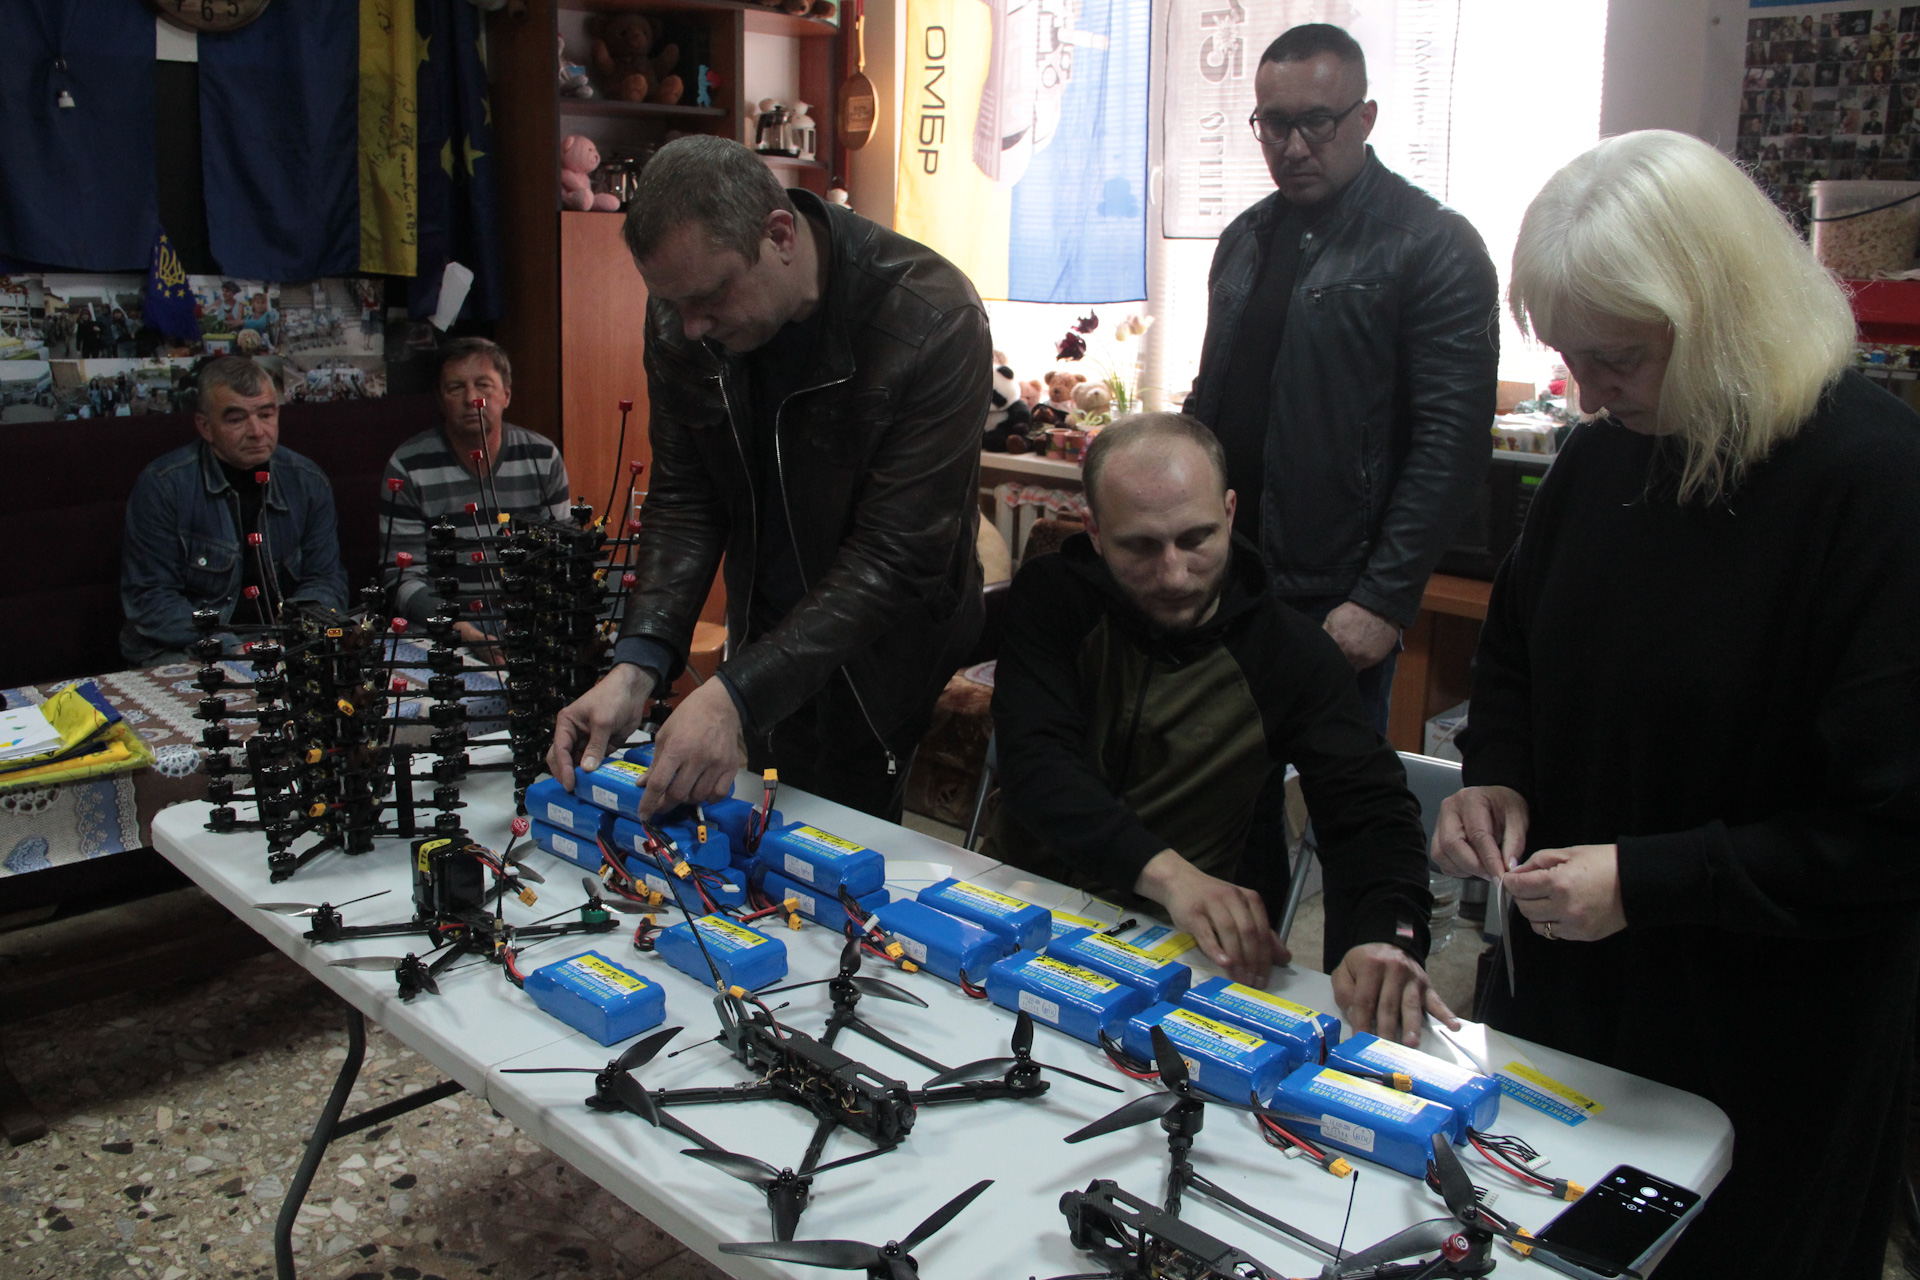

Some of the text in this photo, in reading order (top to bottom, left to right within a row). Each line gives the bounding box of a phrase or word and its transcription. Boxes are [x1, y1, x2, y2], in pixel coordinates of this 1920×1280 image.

[201, 0, 214, 22] 6
[917, 25, 946, 175] ОМБР
[1018, 969, 1038, 977] НЕБА
[1040, 977, 1071, 990] ВІТАННЯ
[1069, 988, 1093, 998] ПАЛКЕ
[1213, 996, 1234, 1005] НЕБА
[1237, 1005, 1272, 1019] ВІТАННЯ
[1270, 1017, 1296, 1028] ПАЛКЕ
[1161, 1020, 1243, 1054] ДЛЯ НЕПРОХАНИХ ГОСТЕЙ
[1179, 1033, 1214, 1048] ВІТАННЯ
[1212, 1046, 1238, 1058] ПАЛКЕ
[1307, 1086, 1331, 1097] НЕБА
[1312, 1082, 1342, 1094] ГОСТЕЙ
[1337, 1096, 1376, 1112] ВІТАННЯ
[1342, 1092, 1392, 1111] НЕПРОХАНИХ
[1514, 1091, 1548, 1108] ВІТАННЯ
[1375, 1109, 1405, 1121] ПАЛКЕ
[1391, 1108, 1408, 1116] ДЛЯ
[1547, 1107, 1573, 1120] ПАЛКЕ
[1355, 1134, 1369, 1142] ВТК
